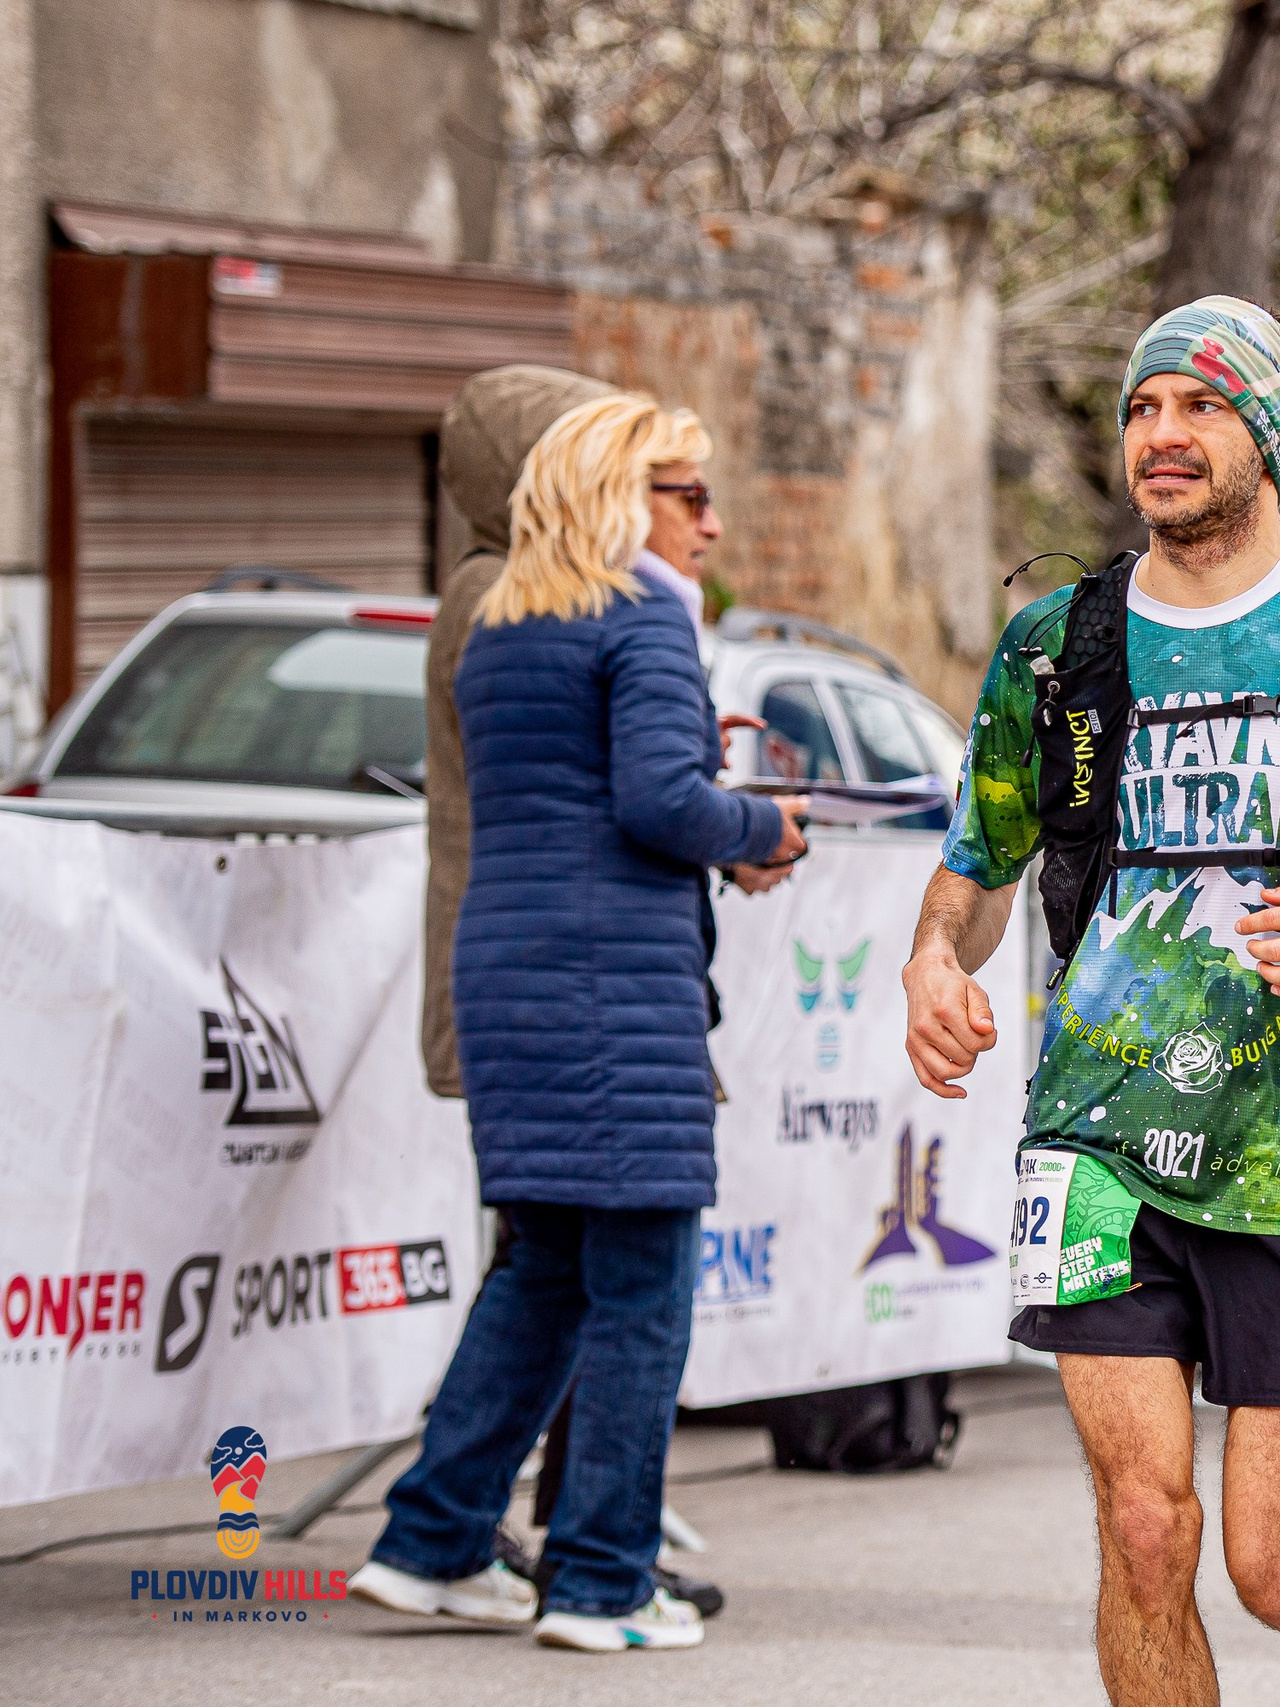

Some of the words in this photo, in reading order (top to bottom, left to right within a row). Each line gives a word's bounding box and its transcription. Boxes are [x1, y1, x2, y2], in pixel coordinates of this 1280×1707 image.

[1118, 770, 1276, 850] ULTRA
[1056, 985, 1152, 1068] PERIENCE
[778, 1084, 880, 1154] Airways
[1143, 1128, 1206, 1180] 2021
[1060, 1254, 1096, 1279] STEP
[1062, 1260, 1131, 1294] MATTERS
